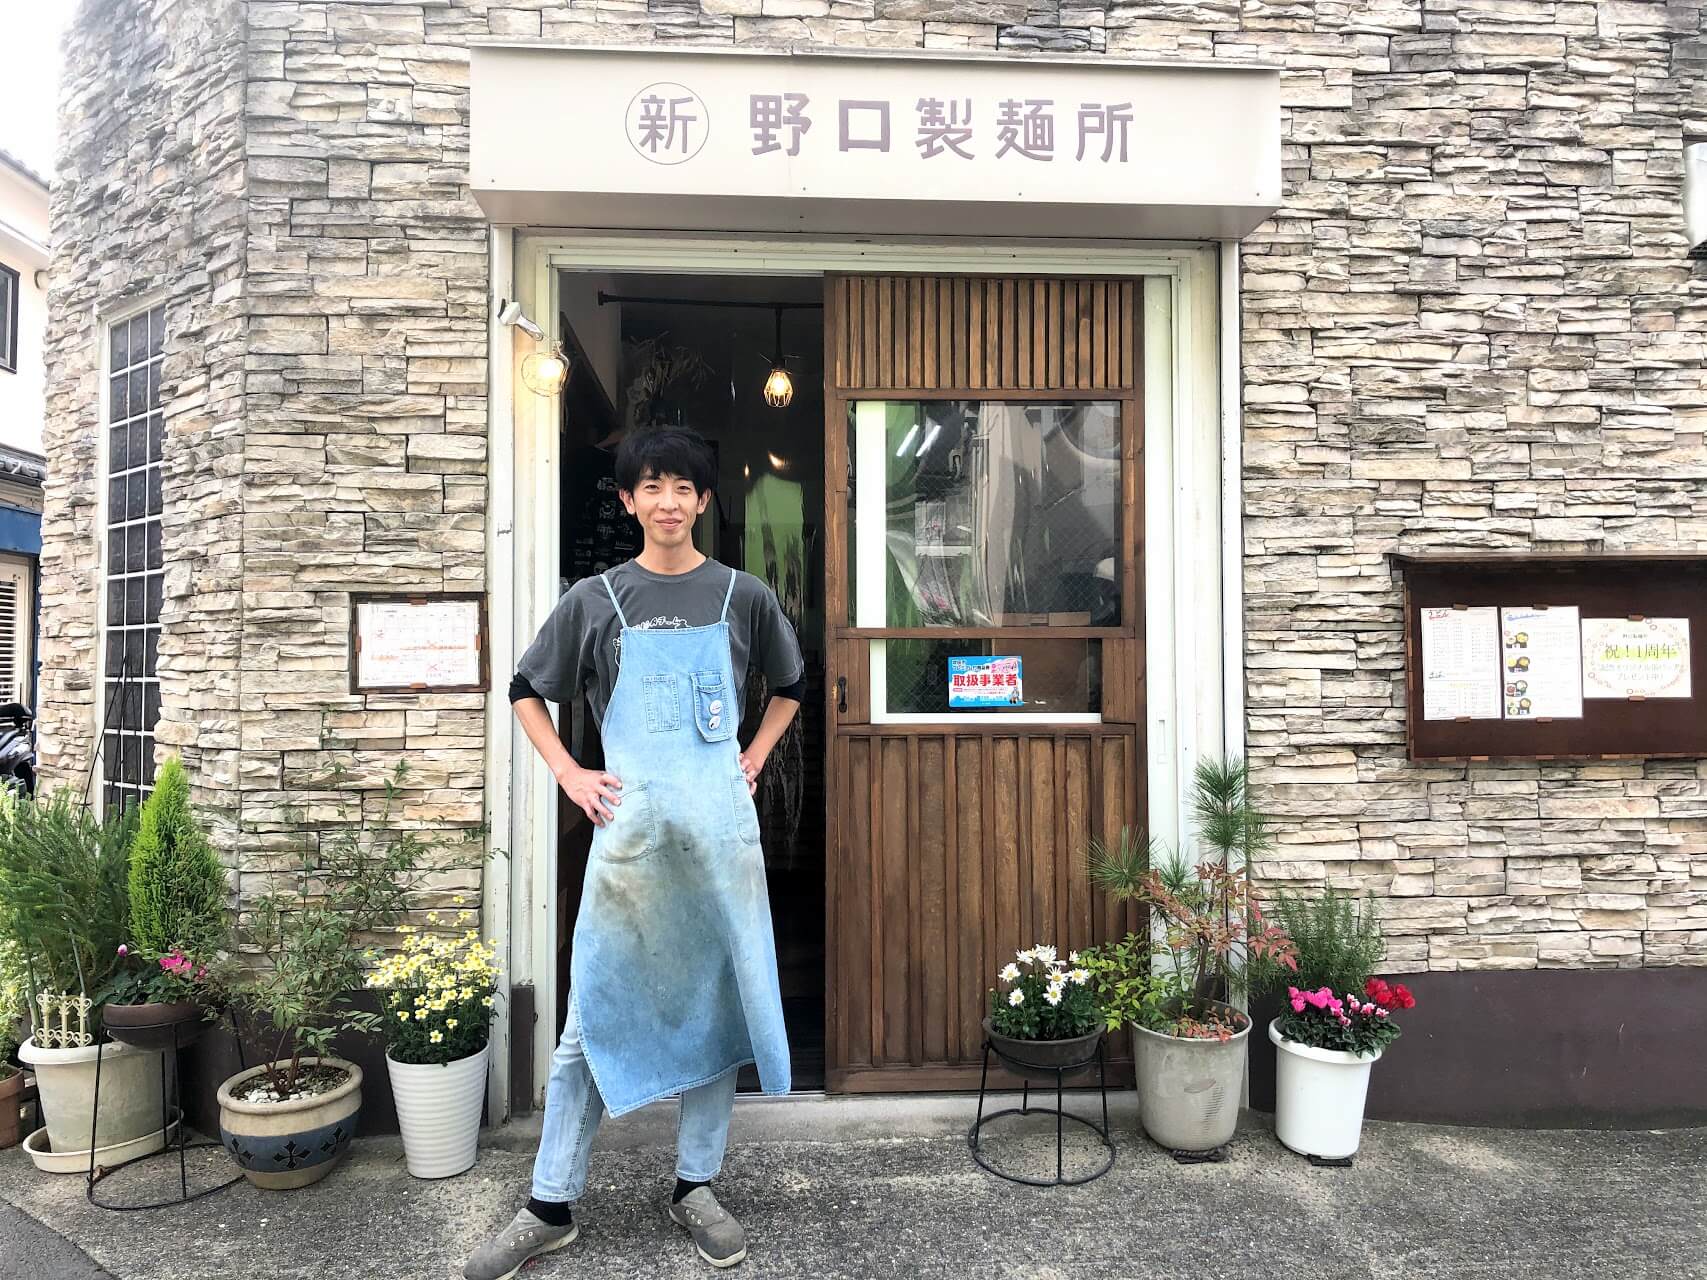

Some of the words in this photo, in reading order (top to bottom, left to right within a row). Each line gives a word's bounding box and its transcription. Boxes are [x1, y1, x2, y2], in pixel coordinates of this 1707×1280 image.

[638, 94, 697, 154] 新
[750, 93, 1134, 163] 野口製麺所
[953, 673, 1017, 687] 取扱事業者
